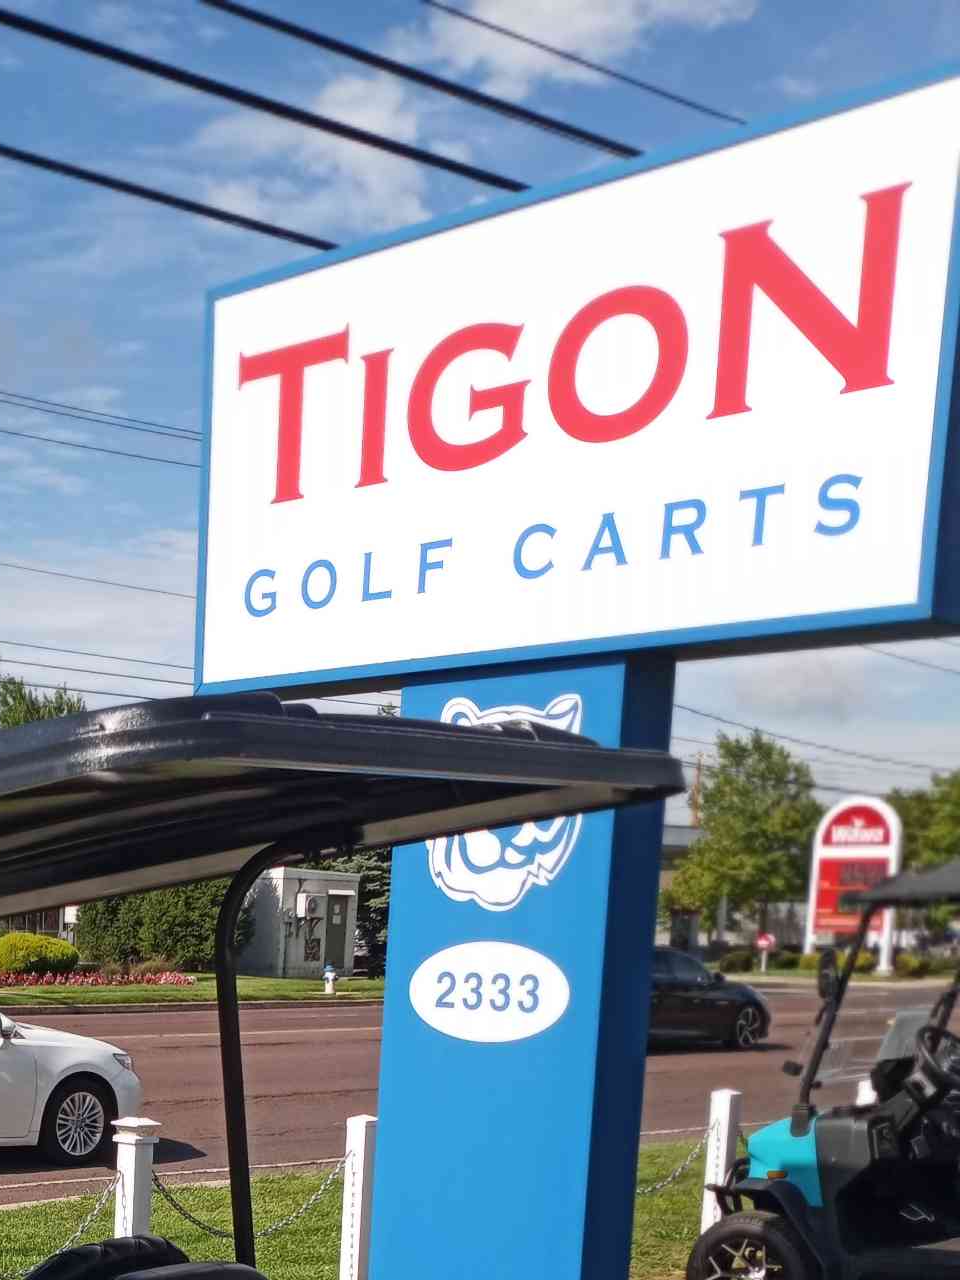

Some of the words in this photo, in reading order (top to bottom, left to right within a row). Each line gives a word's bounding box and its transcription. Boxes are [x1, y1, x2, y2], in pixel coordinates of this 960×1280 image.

[239, 181, 913, 504] TIGON
[244, 538, 452, 617] GOLF
[512, 473, 863, 579] CARTS
[435, 971, 540, 1013] 2333
